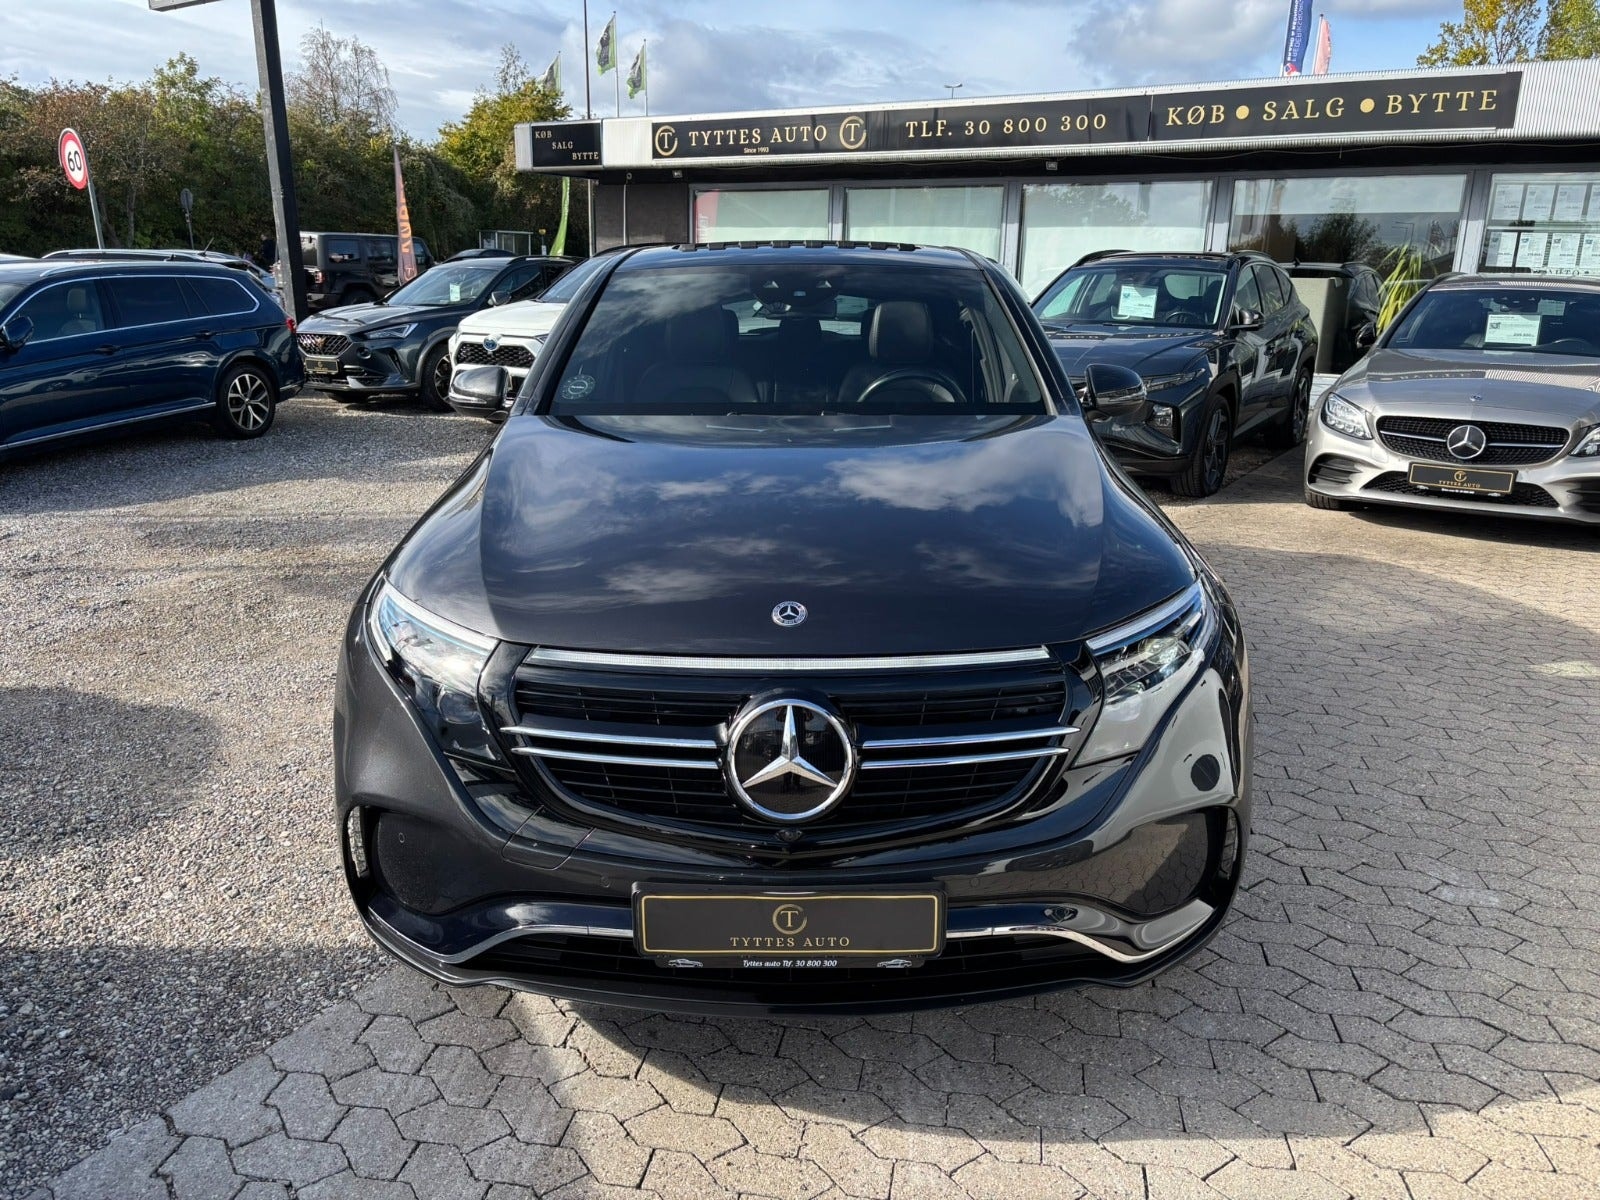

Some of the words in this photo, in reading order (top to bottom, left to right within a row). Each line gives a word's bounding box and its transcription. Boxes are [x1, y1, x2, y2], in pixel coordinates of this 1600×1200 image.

[1166, 104, 1225, 126] KØB
[1262, 97, 1344, 121] SALG
[1385, 89, 1497, 115] BYTTE
[905, 120, 952, 138] TLF.
[964, 120, 991, 136] 30
[1003, 117, 1047, 134] 800
[1060, 114, 1106, 131] 300
[535, 130, 552, 139] KØB
[688, 128, 761, 146] TYTTES
[770, 125, 828, 143] AUTO
[552, 141, 573, 149] SALG
[67, 150, 82, 172] 60
[572, 151, 599, 160] BYTTE
[730, 937, 795, 947] TYTTES
[803, 936, 850, 947] AUTO
[743, 959, 763, 968] Tyttes
